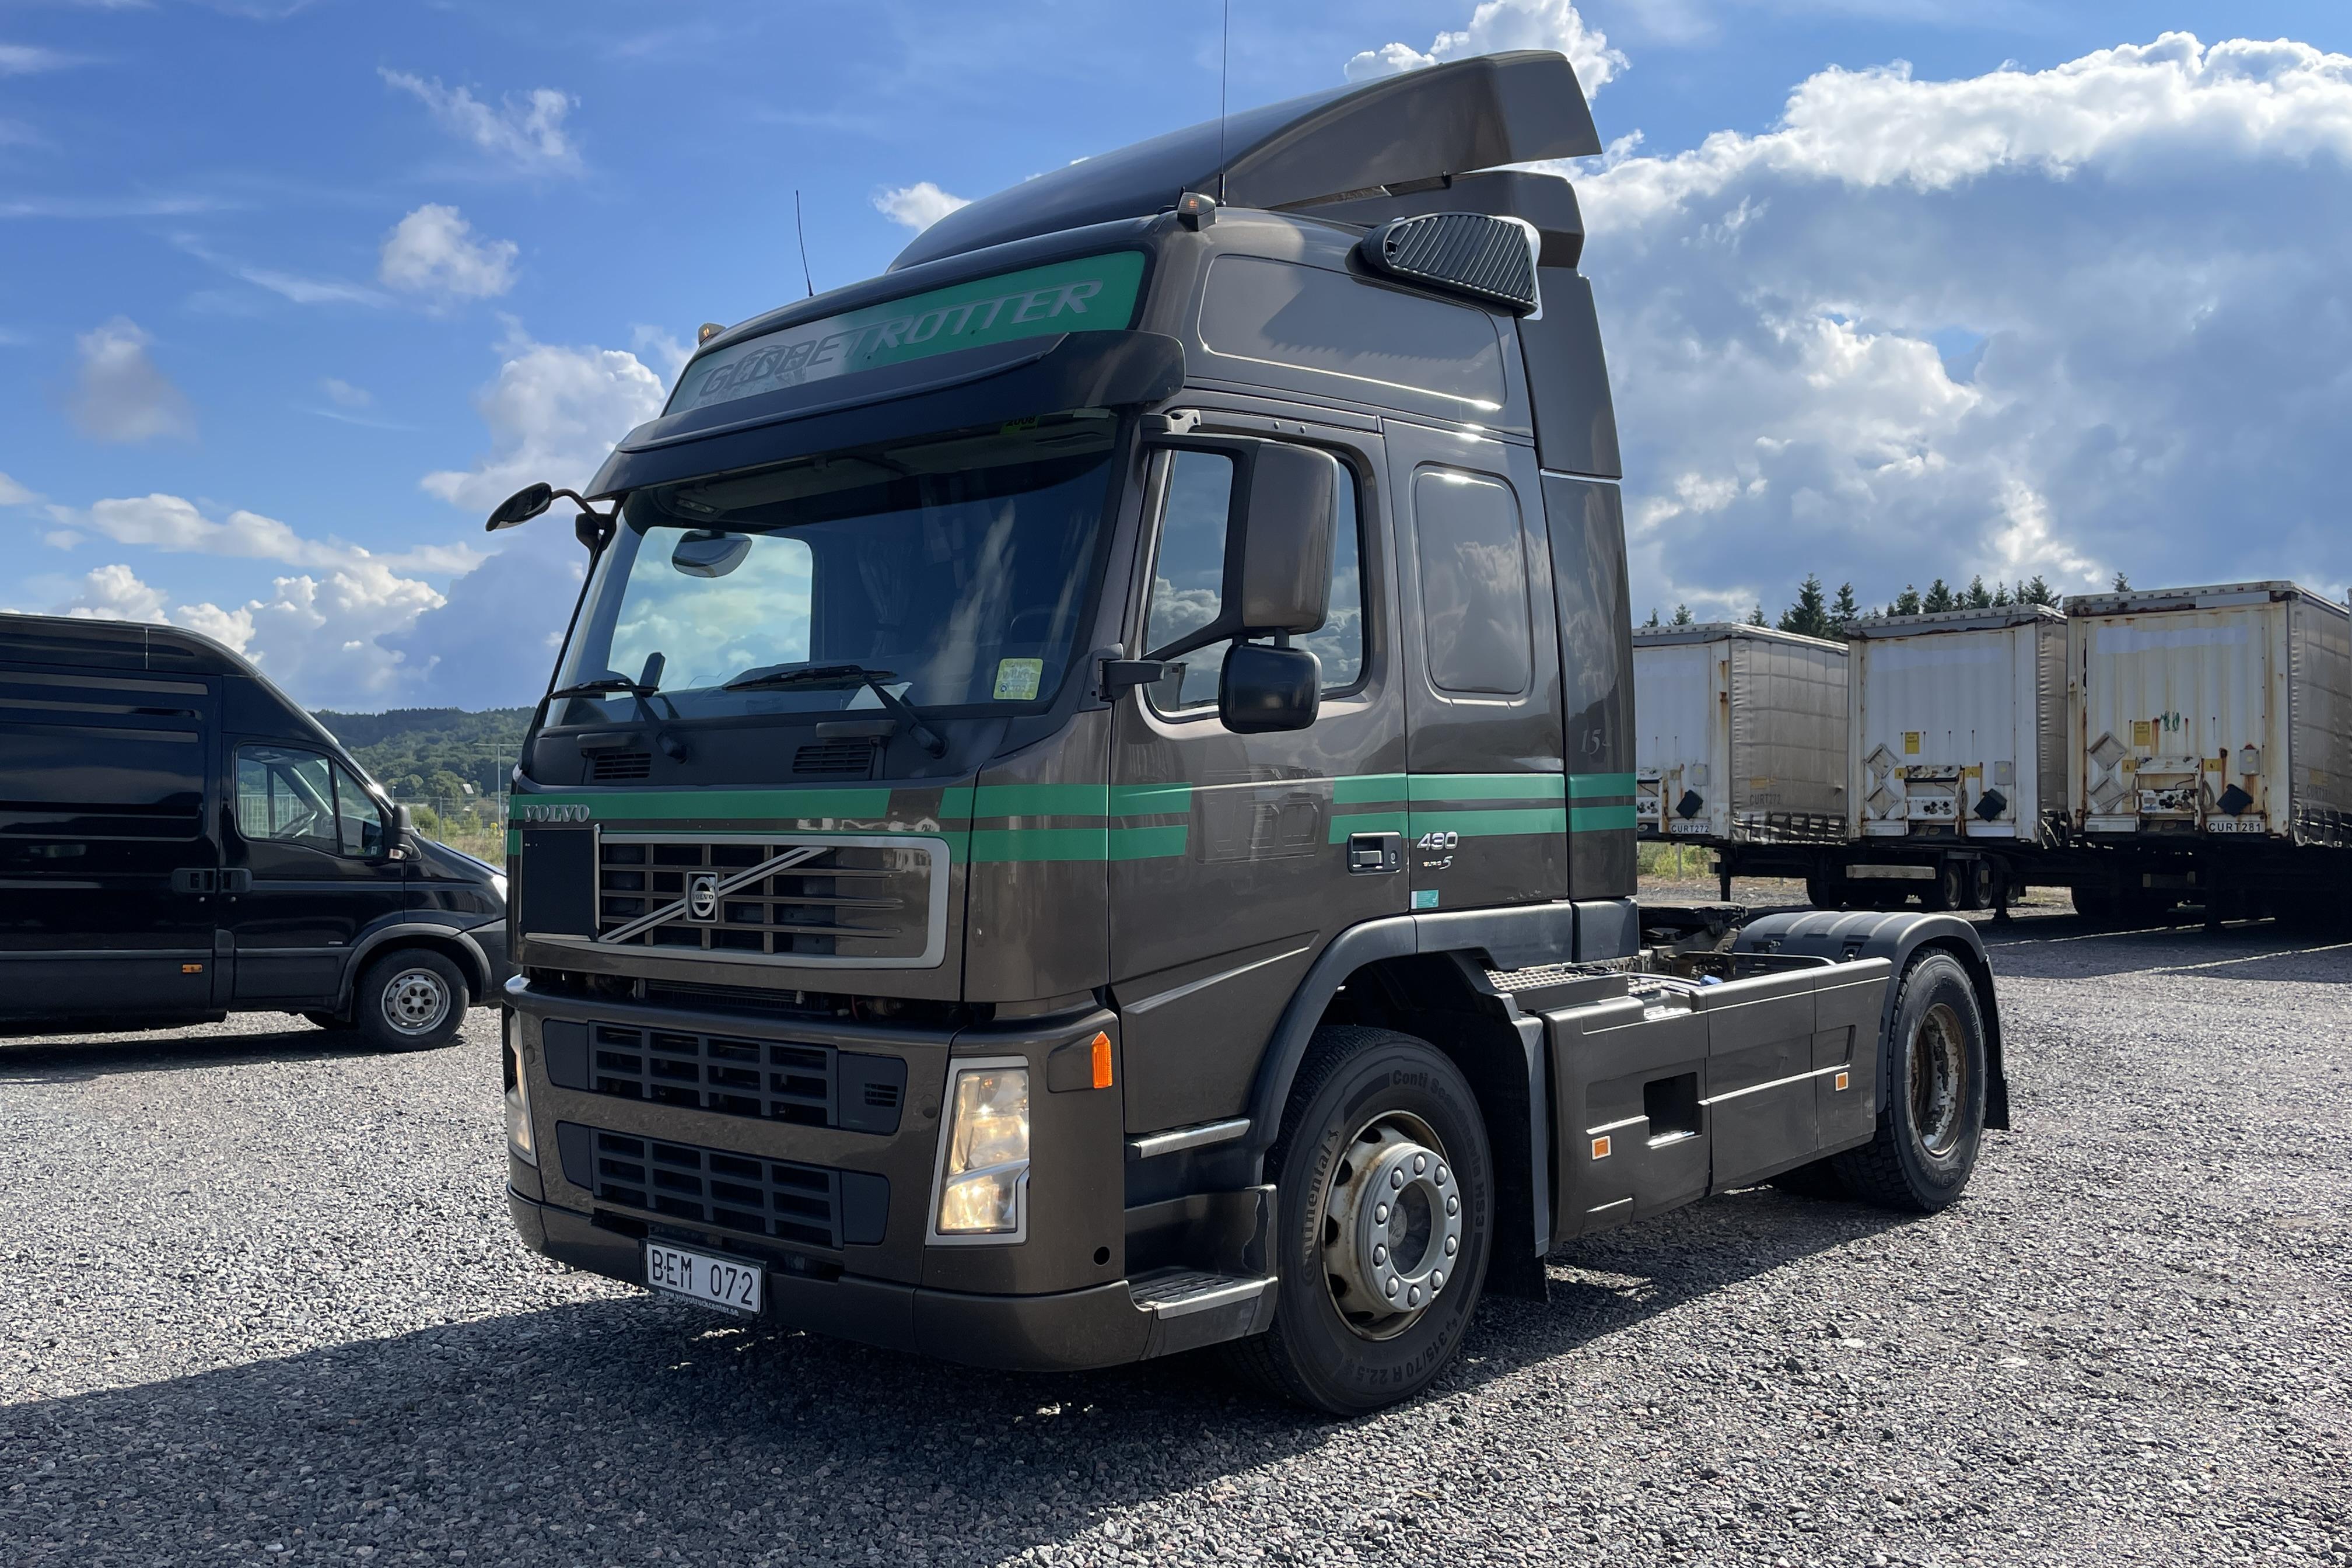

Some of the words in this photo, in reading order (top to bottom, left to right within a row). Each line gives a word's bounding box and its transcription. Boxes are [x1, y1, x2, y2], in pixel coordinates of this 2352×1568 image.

[699, 279, 1104, 397] GLOBETROTTER
[521, 804, 590, 822] VOLVO
[1671, 825, 1709, 833] CURT272
[2208, 822, 2260, 832] CURT281
[1416, 831, 1458, 851] 430
[1393, 1070, 1429, 1088] Conti
[1430, 1077, 1482, 1178] Scandinavia
[1474, 1181, 1486, 1228] HS3
[652, 1249, 692, 1290] BEM
[710, 1264, 753, 1306] 072
[658, 1289, 740, 1317] www.volvotruckcenter.se
[1406, 1331, 1448, 1378] 315/70
[1357, 1366, 1388, 1385] 22.5
[1392, 1366, 1403, 1382] R
